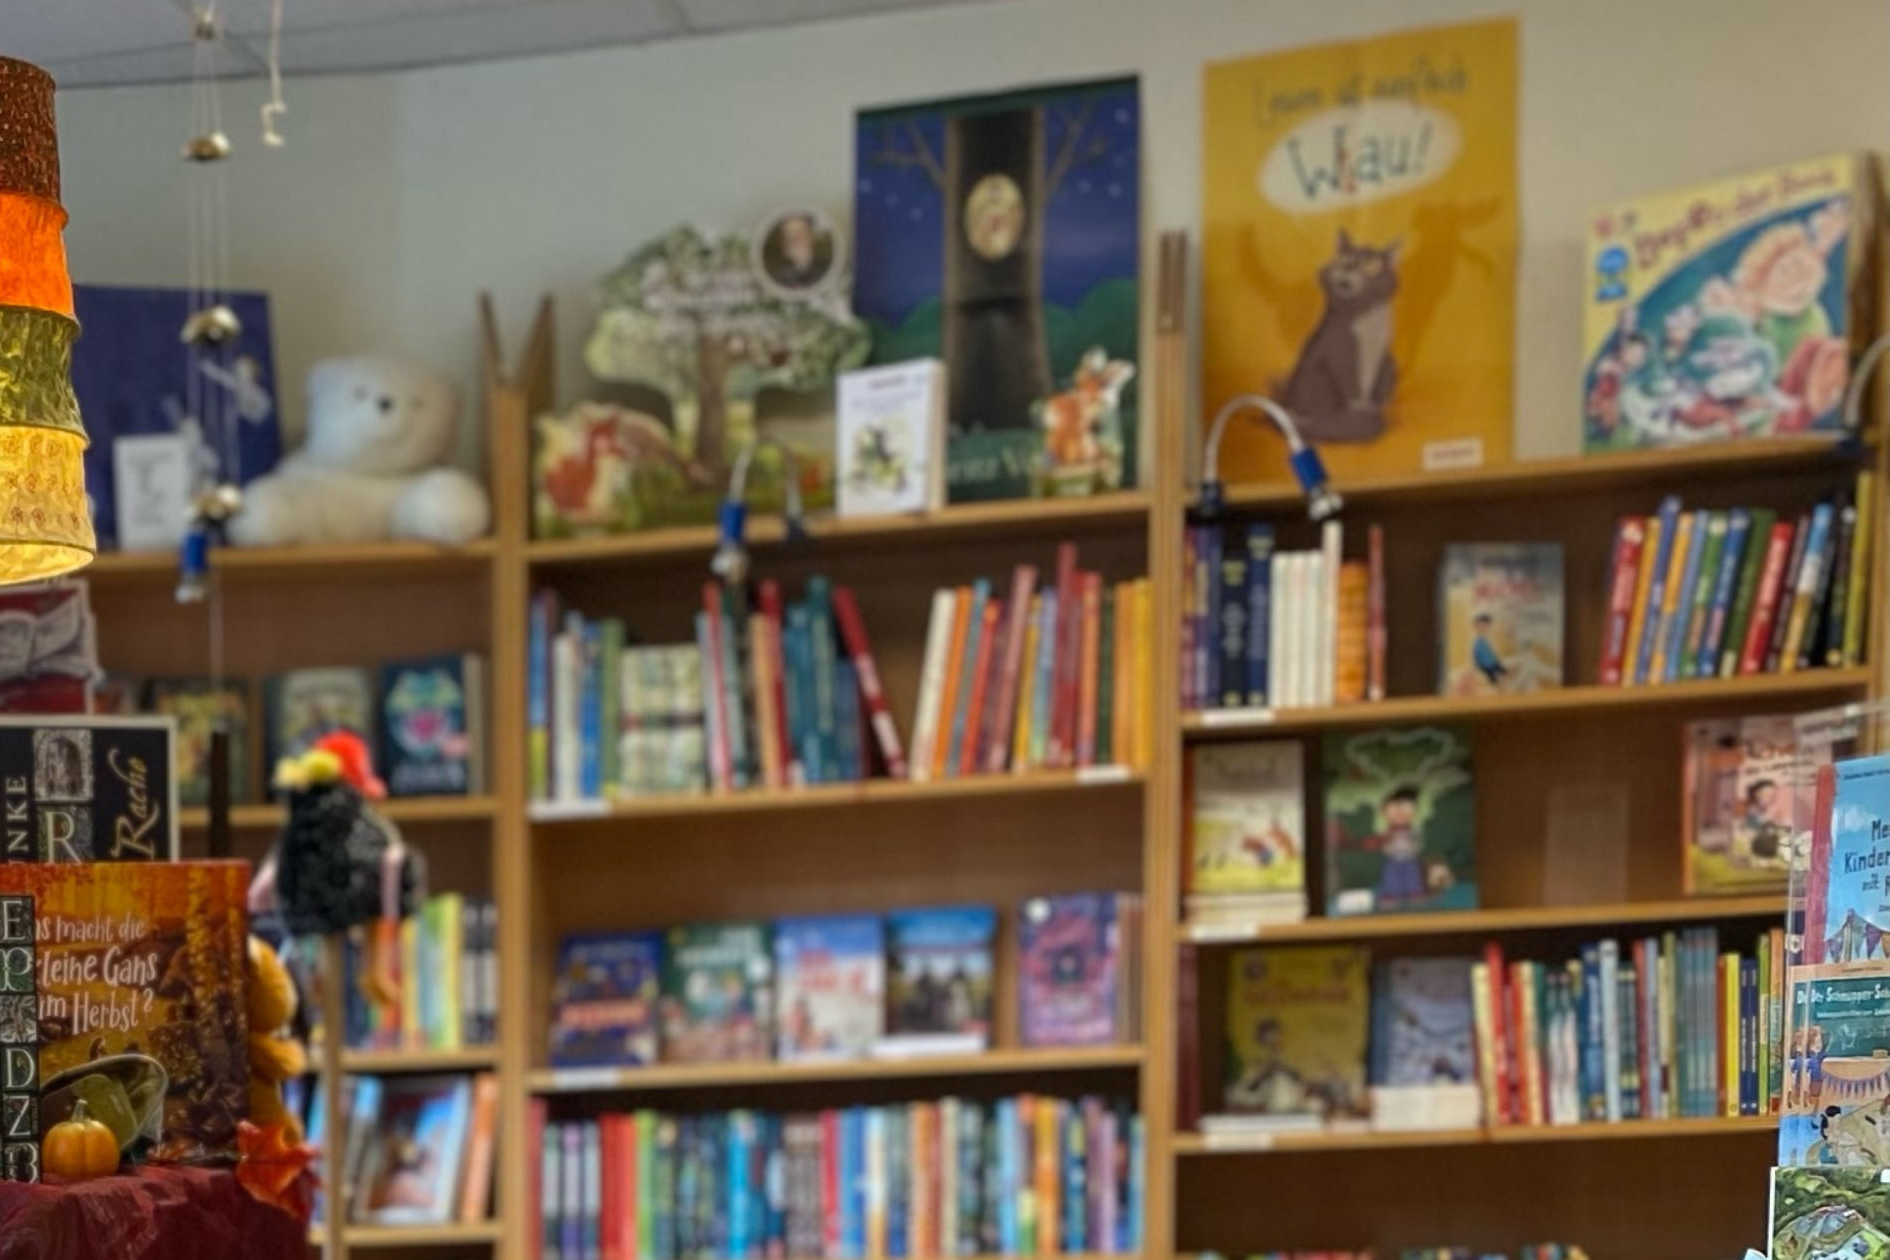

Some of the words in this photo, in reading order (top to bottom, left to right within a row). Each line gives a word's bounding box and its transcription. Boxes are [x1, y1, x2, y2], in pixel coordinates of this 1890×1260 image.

[56, 914, 116, 943] macht
[118, 910, 147, 940] die
[36, 951, 97, 987] leine
[103, 946, 158, 987] Gans
[38, 995, 67, 1020] im
